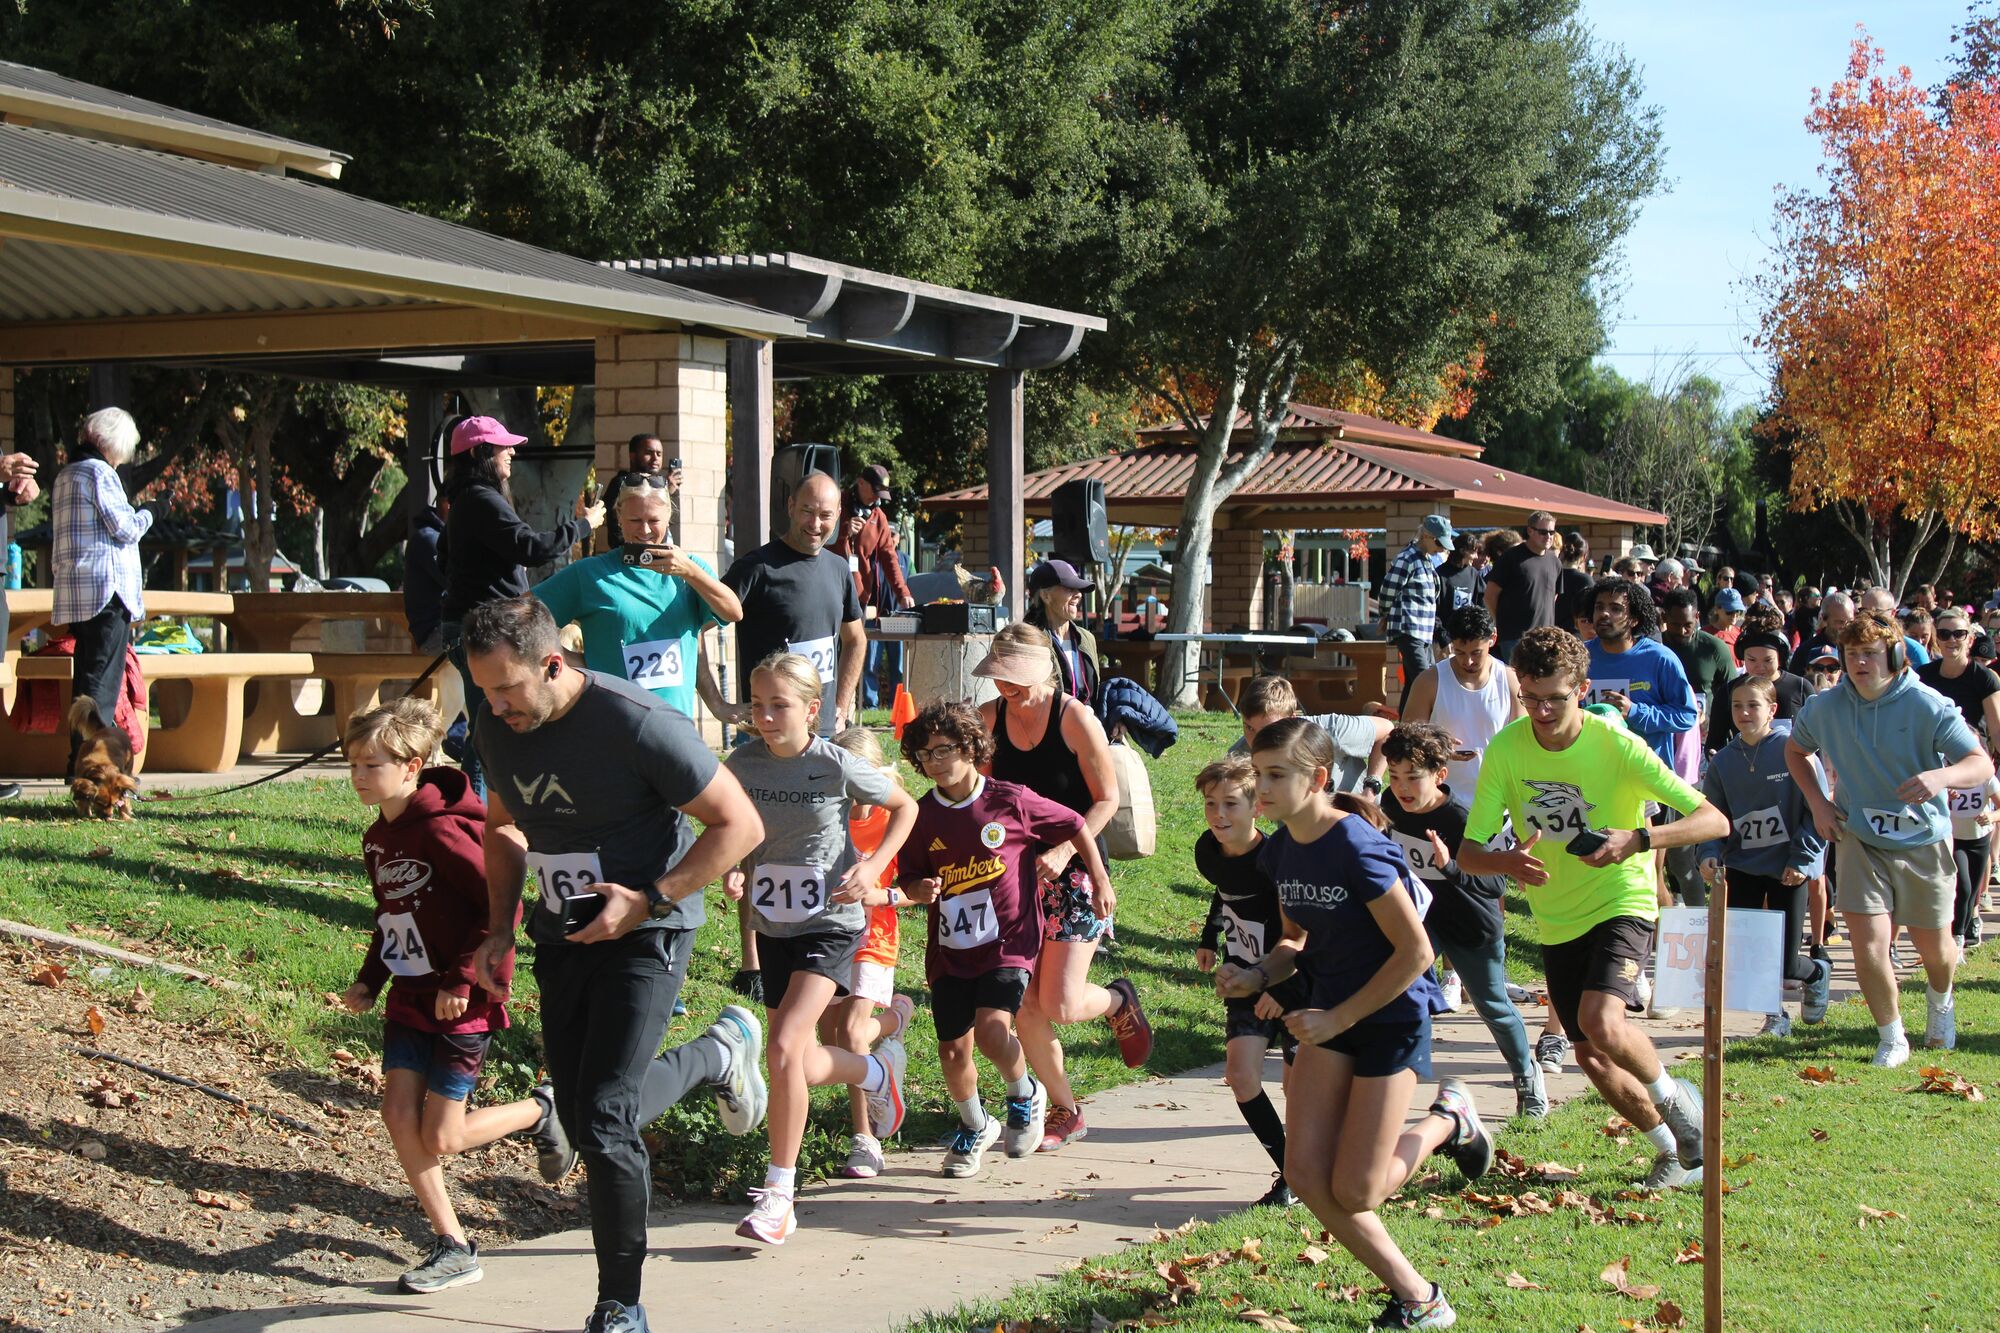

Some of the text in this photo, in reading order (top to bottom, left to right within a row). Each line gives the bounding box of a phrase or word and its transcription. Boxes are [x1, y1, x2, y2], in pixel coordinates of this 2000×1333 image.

[628, 650, 680, 680] 223
[749, 787, 826, 804] ATEADORES
[555, 807, 577, 815] RVCA
[1740, 816, 1783, 840] 272
[939, 854, 1005, 891] Timbers
[756, 876, 820, 909] 213
[1276, 879, 1349, 905] ighthouse
[1223, 915, 1260, 958] 260
